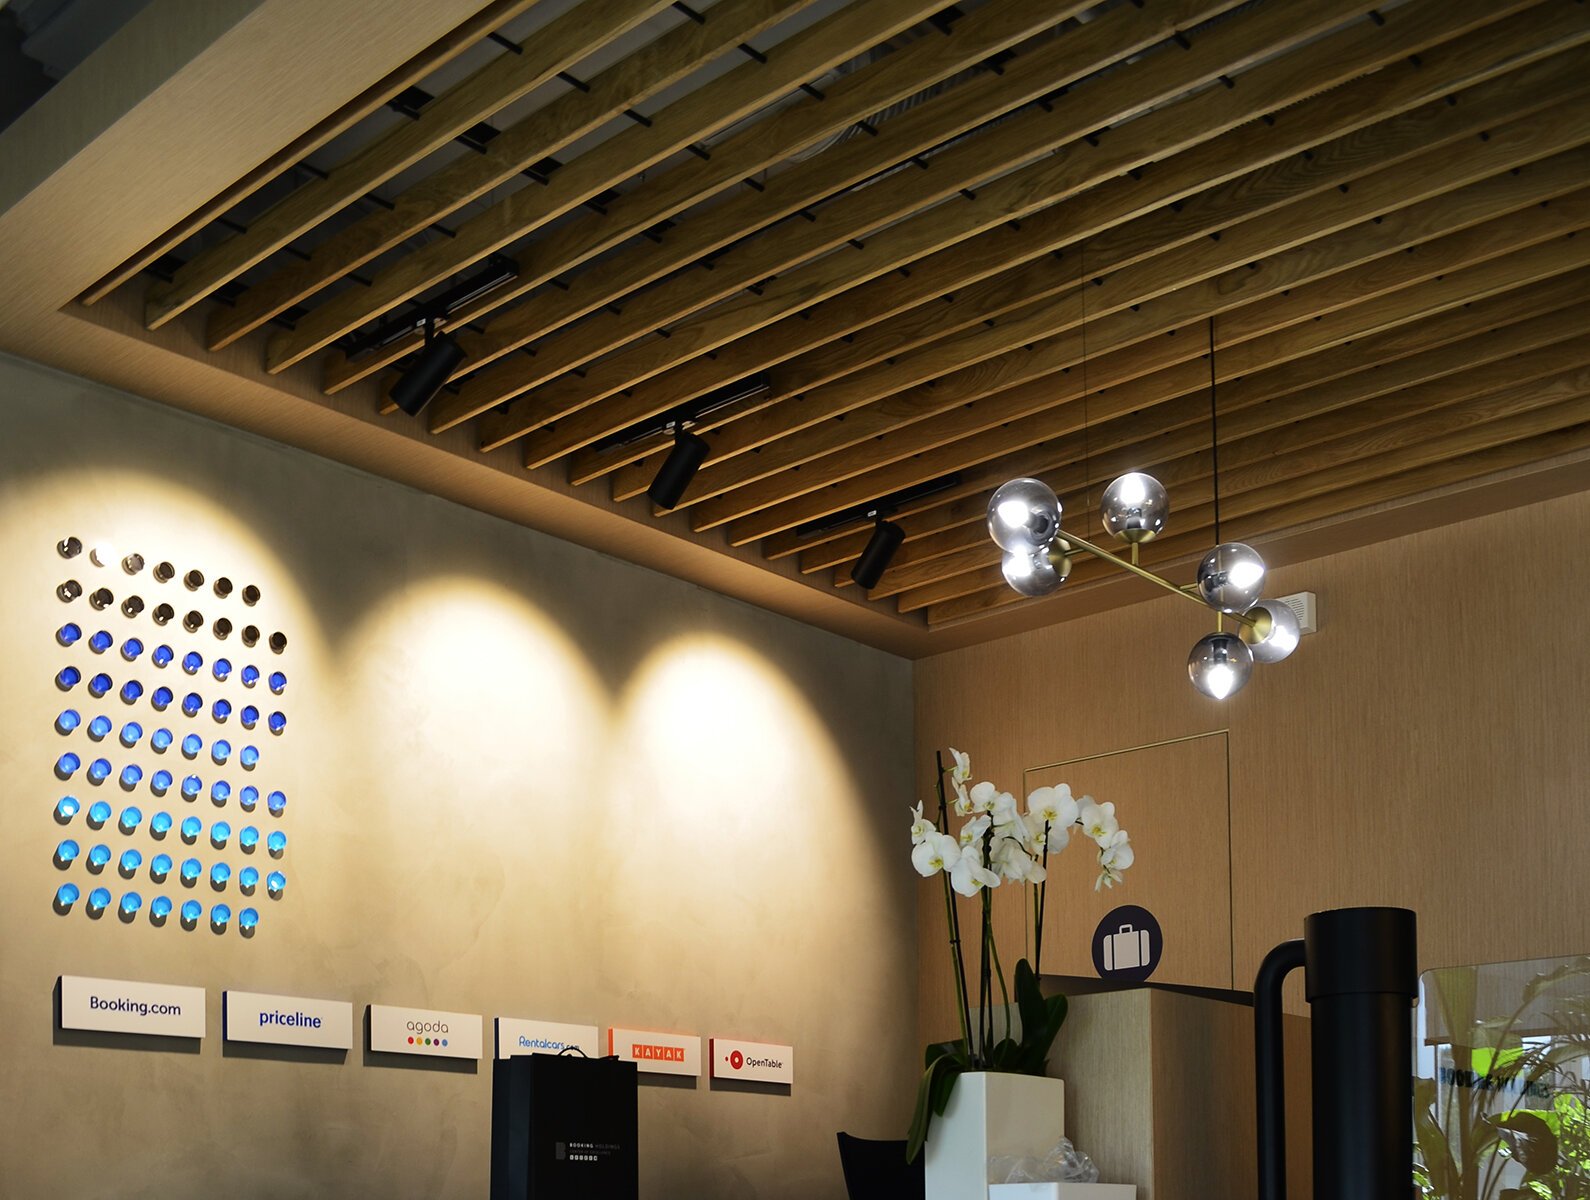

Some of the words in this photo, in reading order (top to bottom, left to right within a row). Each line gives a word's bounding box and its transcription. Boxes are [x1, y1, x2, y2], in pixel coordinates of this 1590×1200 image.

[90, 996, 181, 1016] Booking.com
[259, 1010, 322, 1028] priceline
[406, 1020, 449, 1035] agoda
[518, 1035, 580, 1051] Rentalcarscm
[633, 1046, 683, 1060] KAYAK
[746, 1057, 782, 1069] OpenTable
